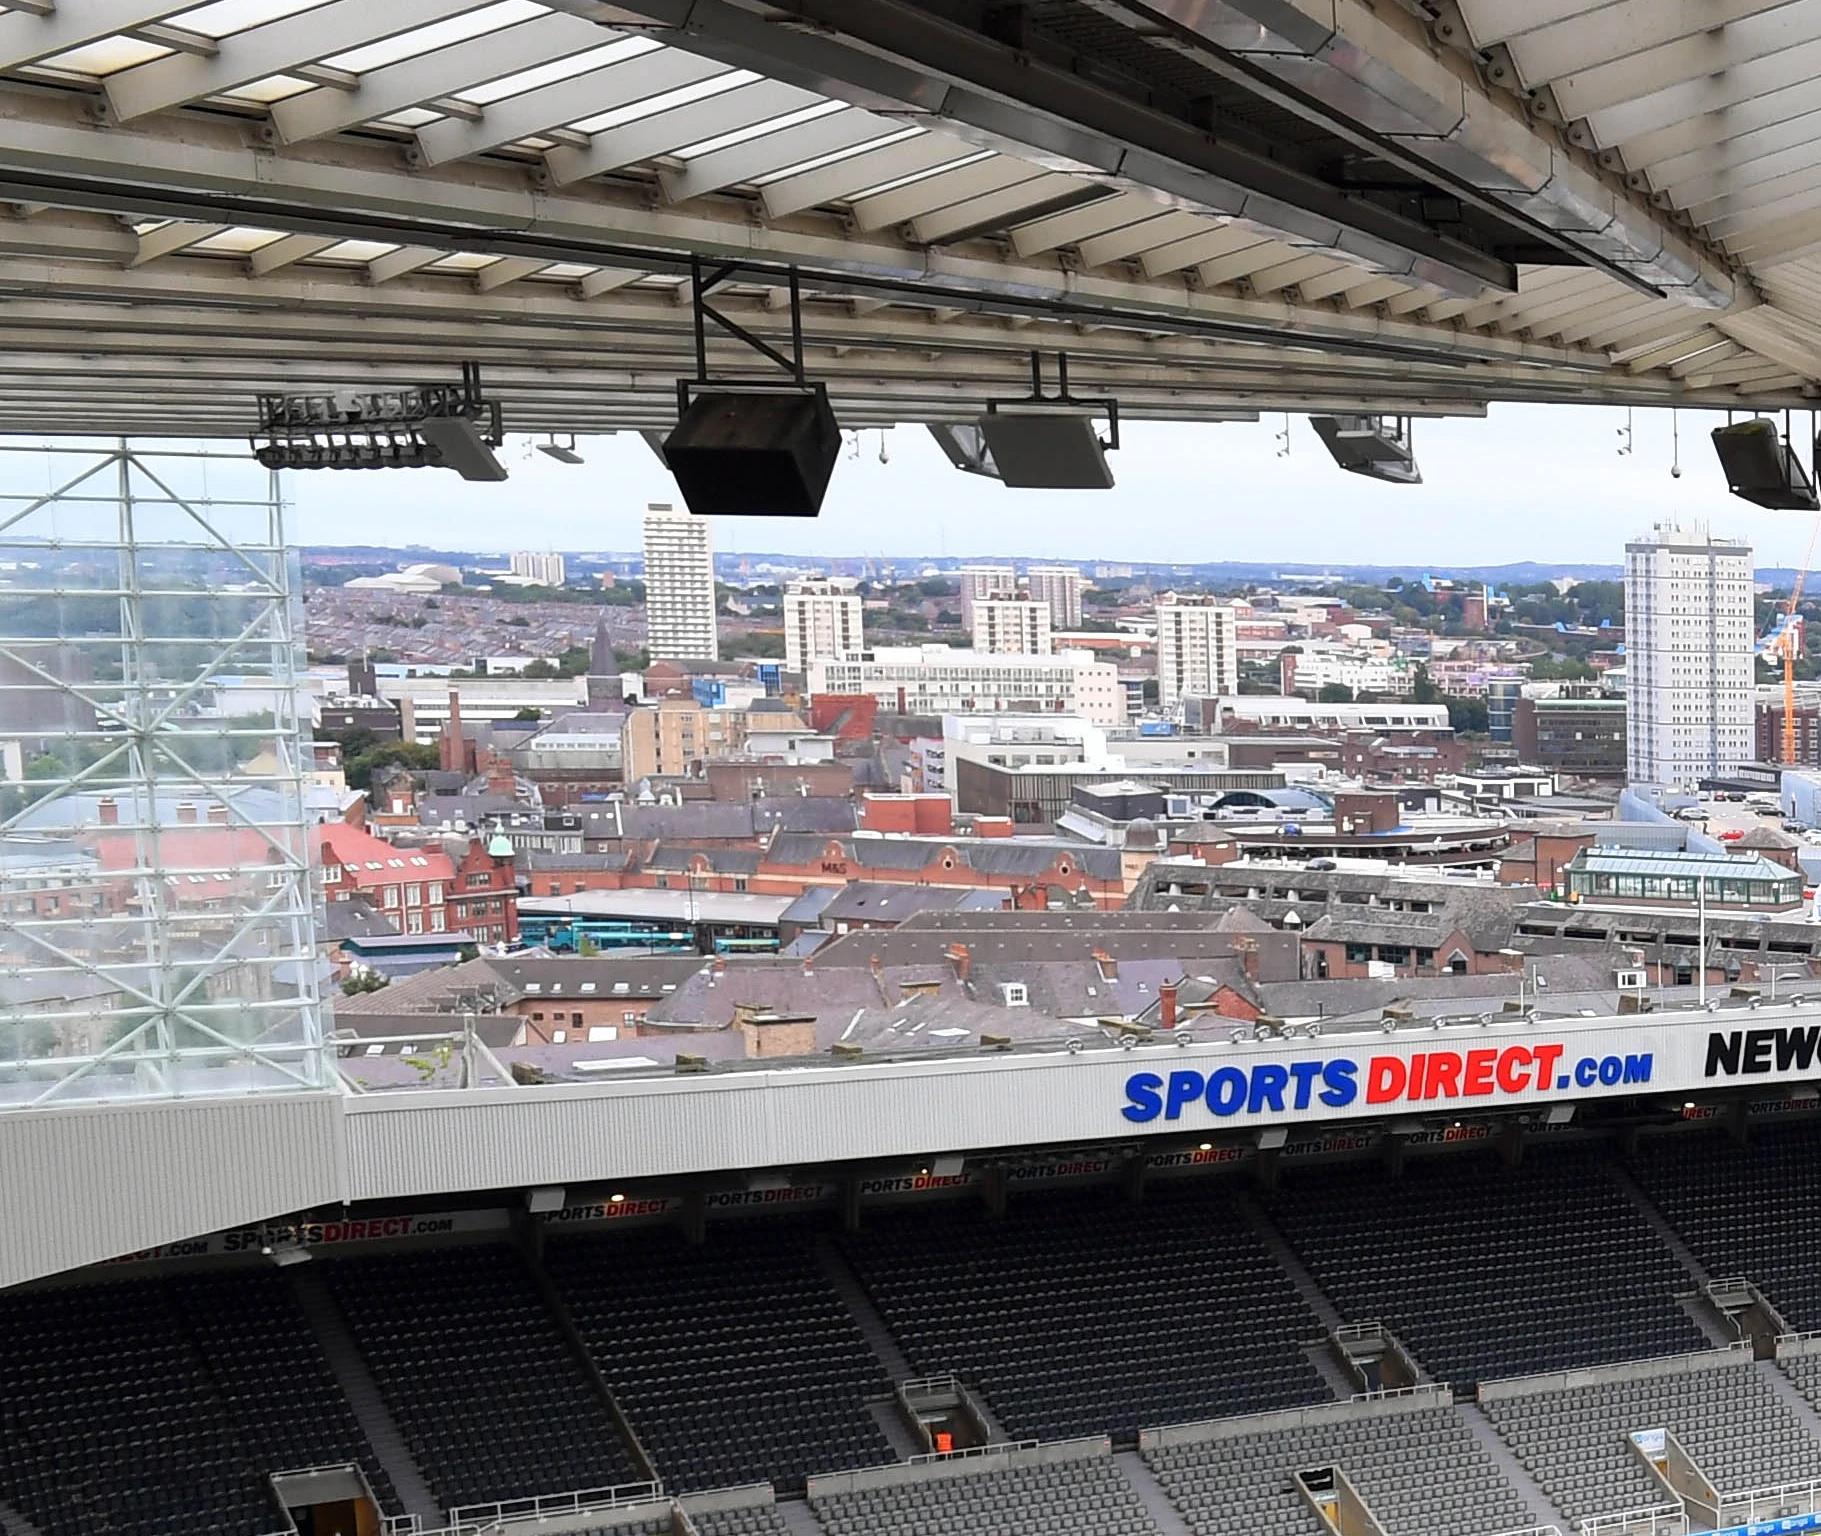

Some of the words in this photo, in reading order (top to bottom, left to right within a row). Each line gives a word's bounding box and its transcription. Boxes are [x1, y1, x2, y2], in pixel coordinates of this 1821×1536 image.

[821, 862, 847, 874] M&S
[1121, 1043, 1654, 1123] SPORTSDIRECT.COM
[862, 1174, 969, 1193] PORTSDIRECT
